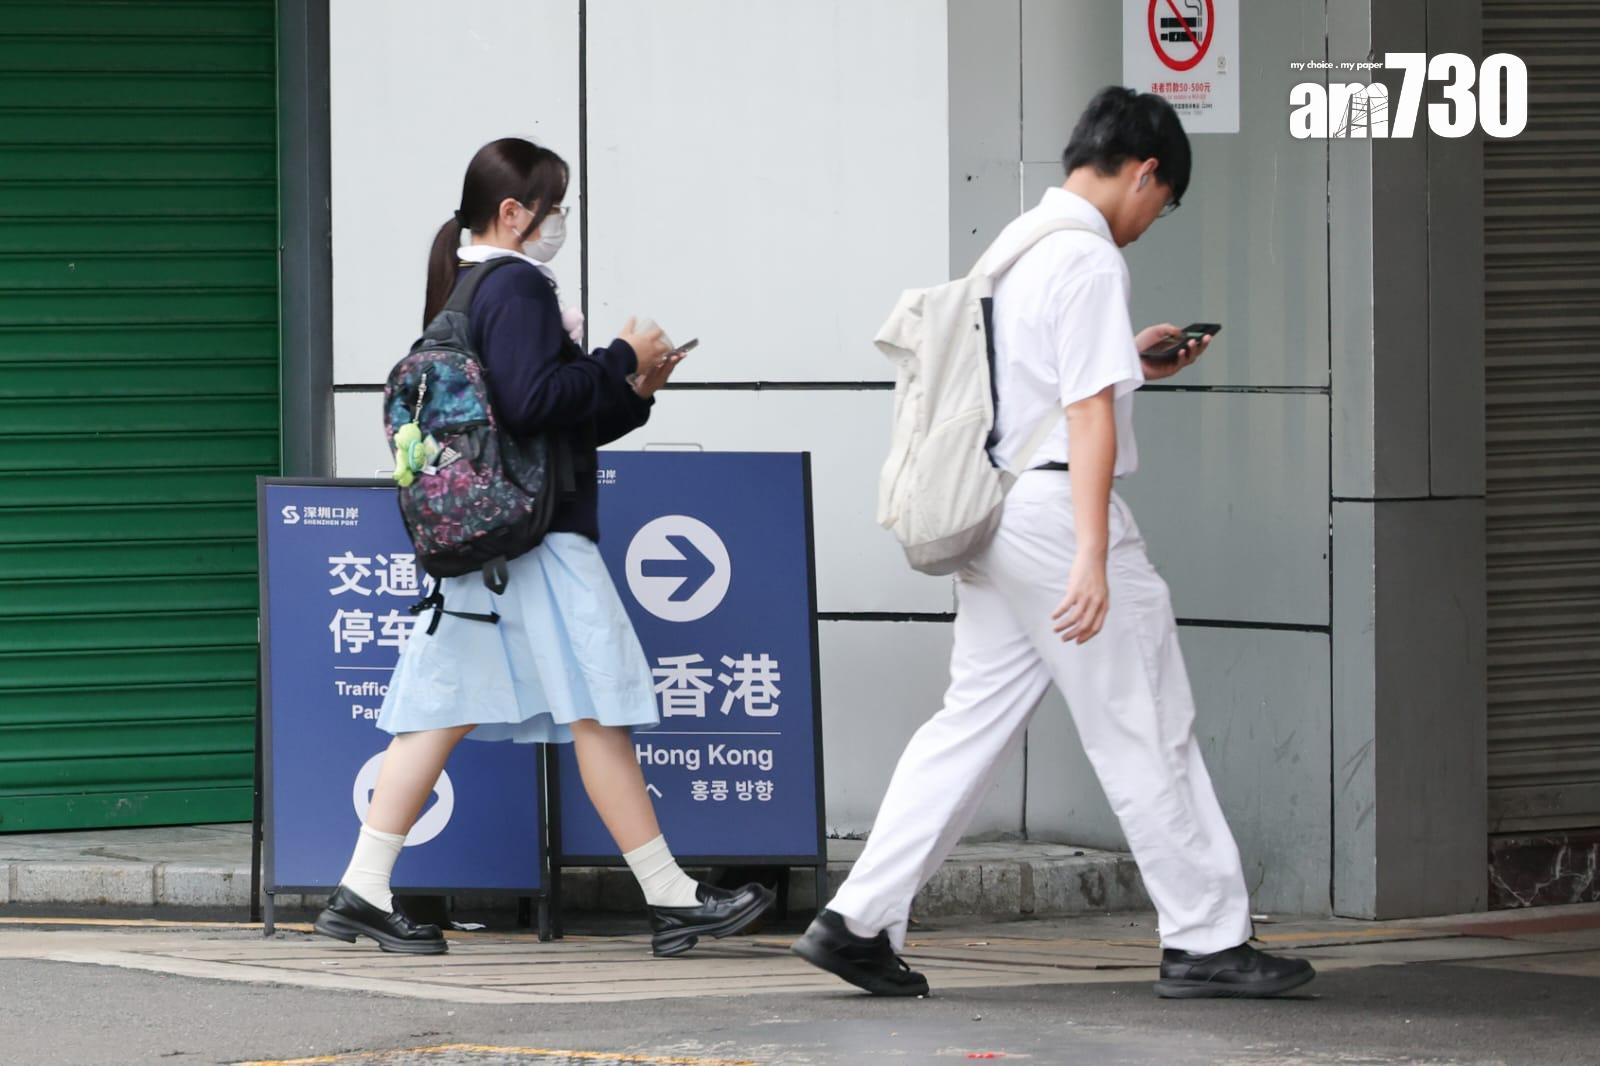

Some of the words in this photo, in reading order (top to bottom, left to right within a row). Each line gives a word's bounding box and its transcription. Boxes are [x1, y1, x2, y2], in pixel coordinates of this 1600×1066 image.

[303, 506, 359, 519] 深圳口岸
[328, 550, 435, 597] 交通
[328, 608, 416, 655] 停车
[334, 680, 389, 696] Traffic
[651, 653, 781, 718] 香港
[635, 743, 701, 771] Hong
[708, 744, 774, 771] Kong
[690, 779, 729, 801] 홍콩
[735, 779, 774, 801] 방향
